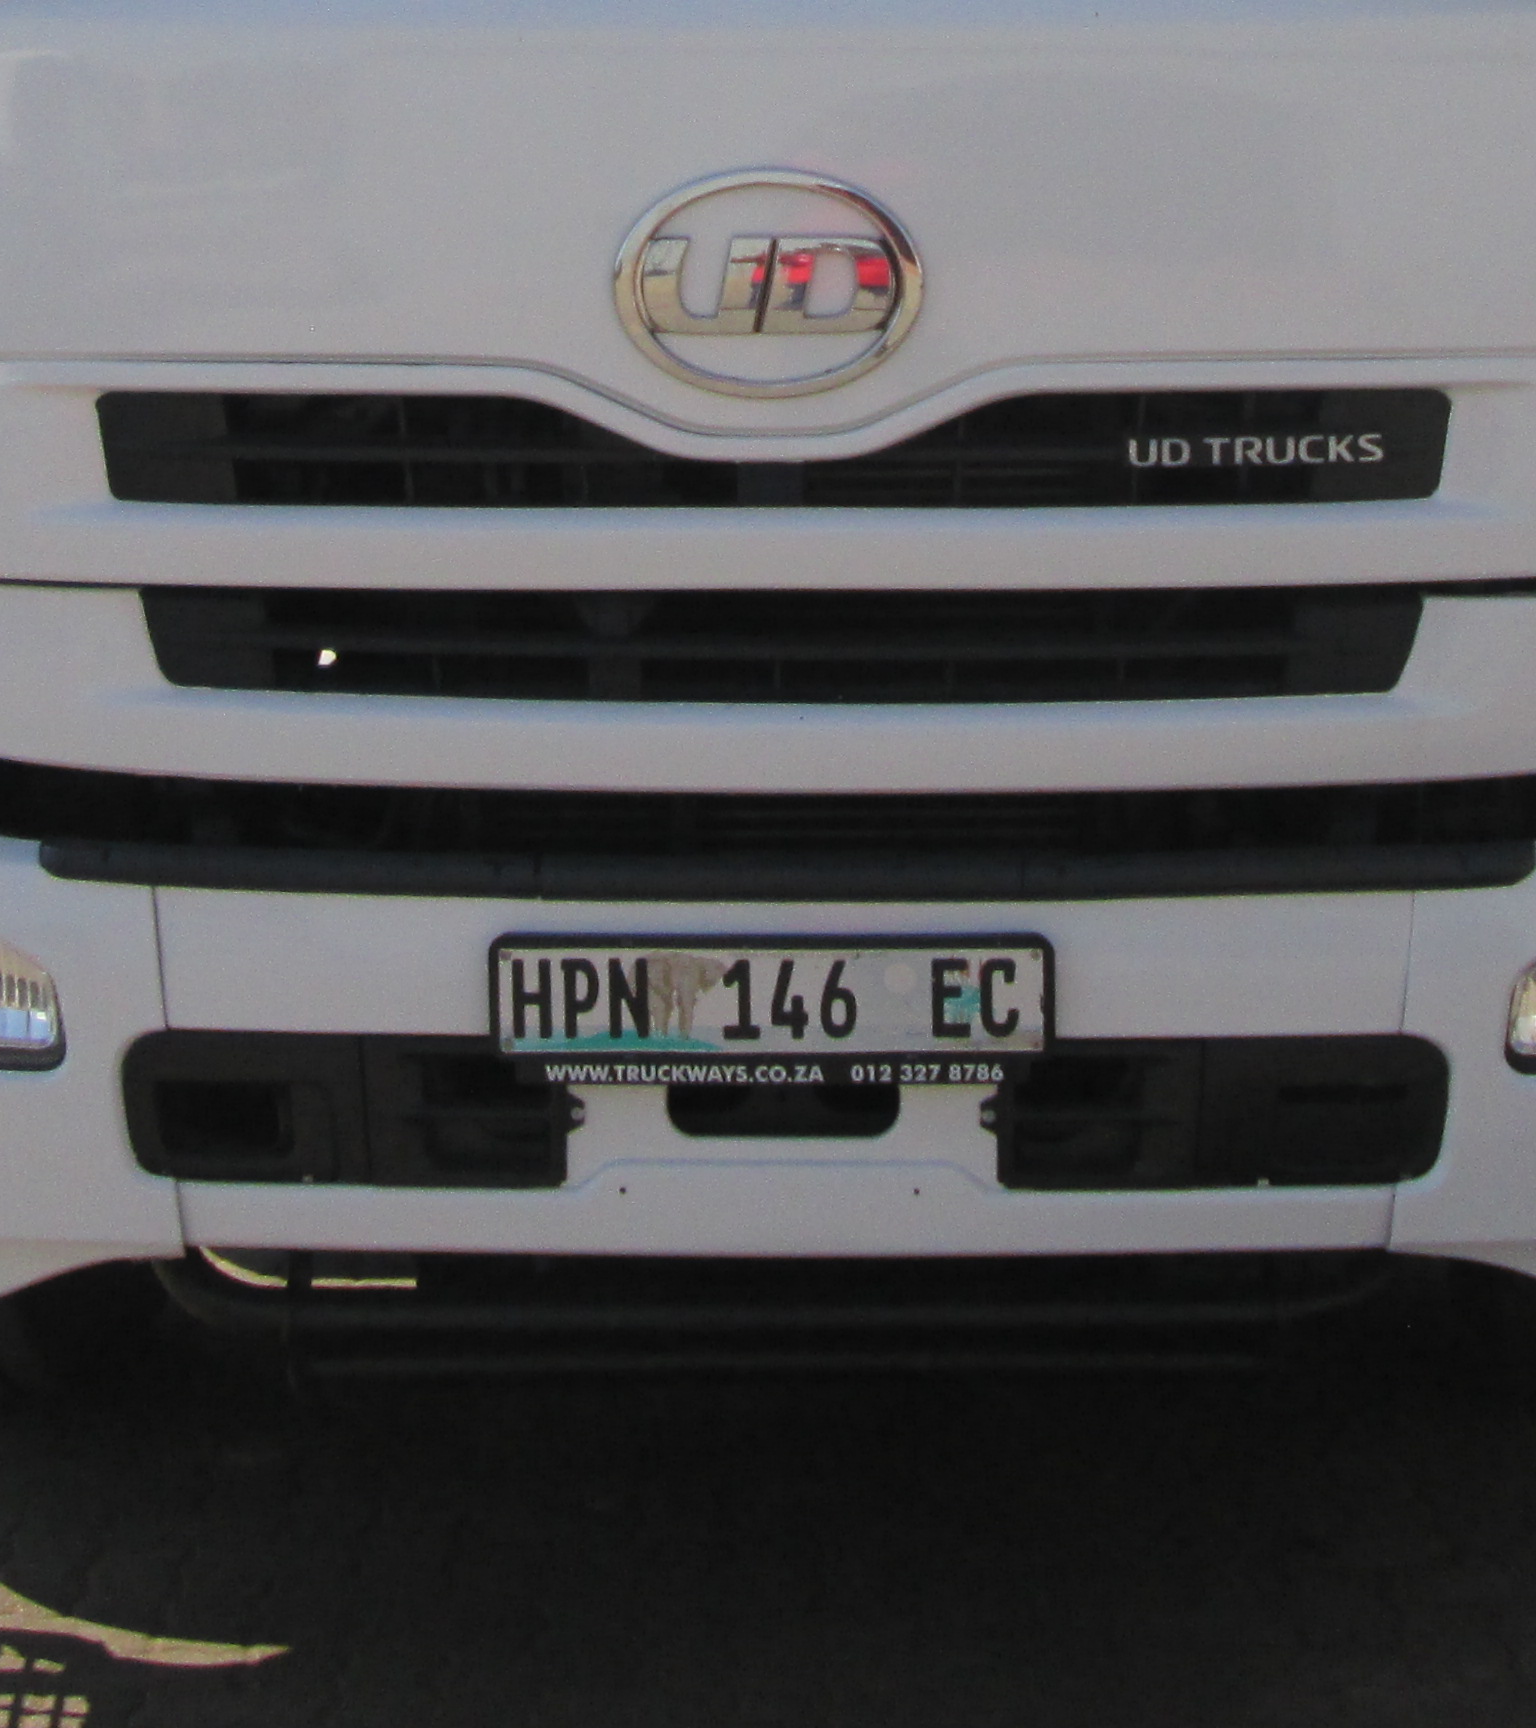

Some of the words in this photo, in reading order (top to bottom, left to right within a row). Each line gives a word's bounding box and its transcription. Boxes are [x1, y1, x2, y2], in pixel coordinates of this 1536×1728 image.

[642, 237, 896, 334] UD
[1128, 437, 1191, 467] UD
[1202, 433, 1384, 466] TRUCKS
[511, 958, 650, 1039] HPN
[722, 959, 858, 1041] 146
[930, 958, 1020, 1038] EC
[544, 1064, 824, 1083] WWW.TRUCKWAYS.CO.ZA
[850, 1063, 892, 1082] 012
[900, 1063, 941, 1082] 327
[948, 1063, 1004, 1082] 8786
